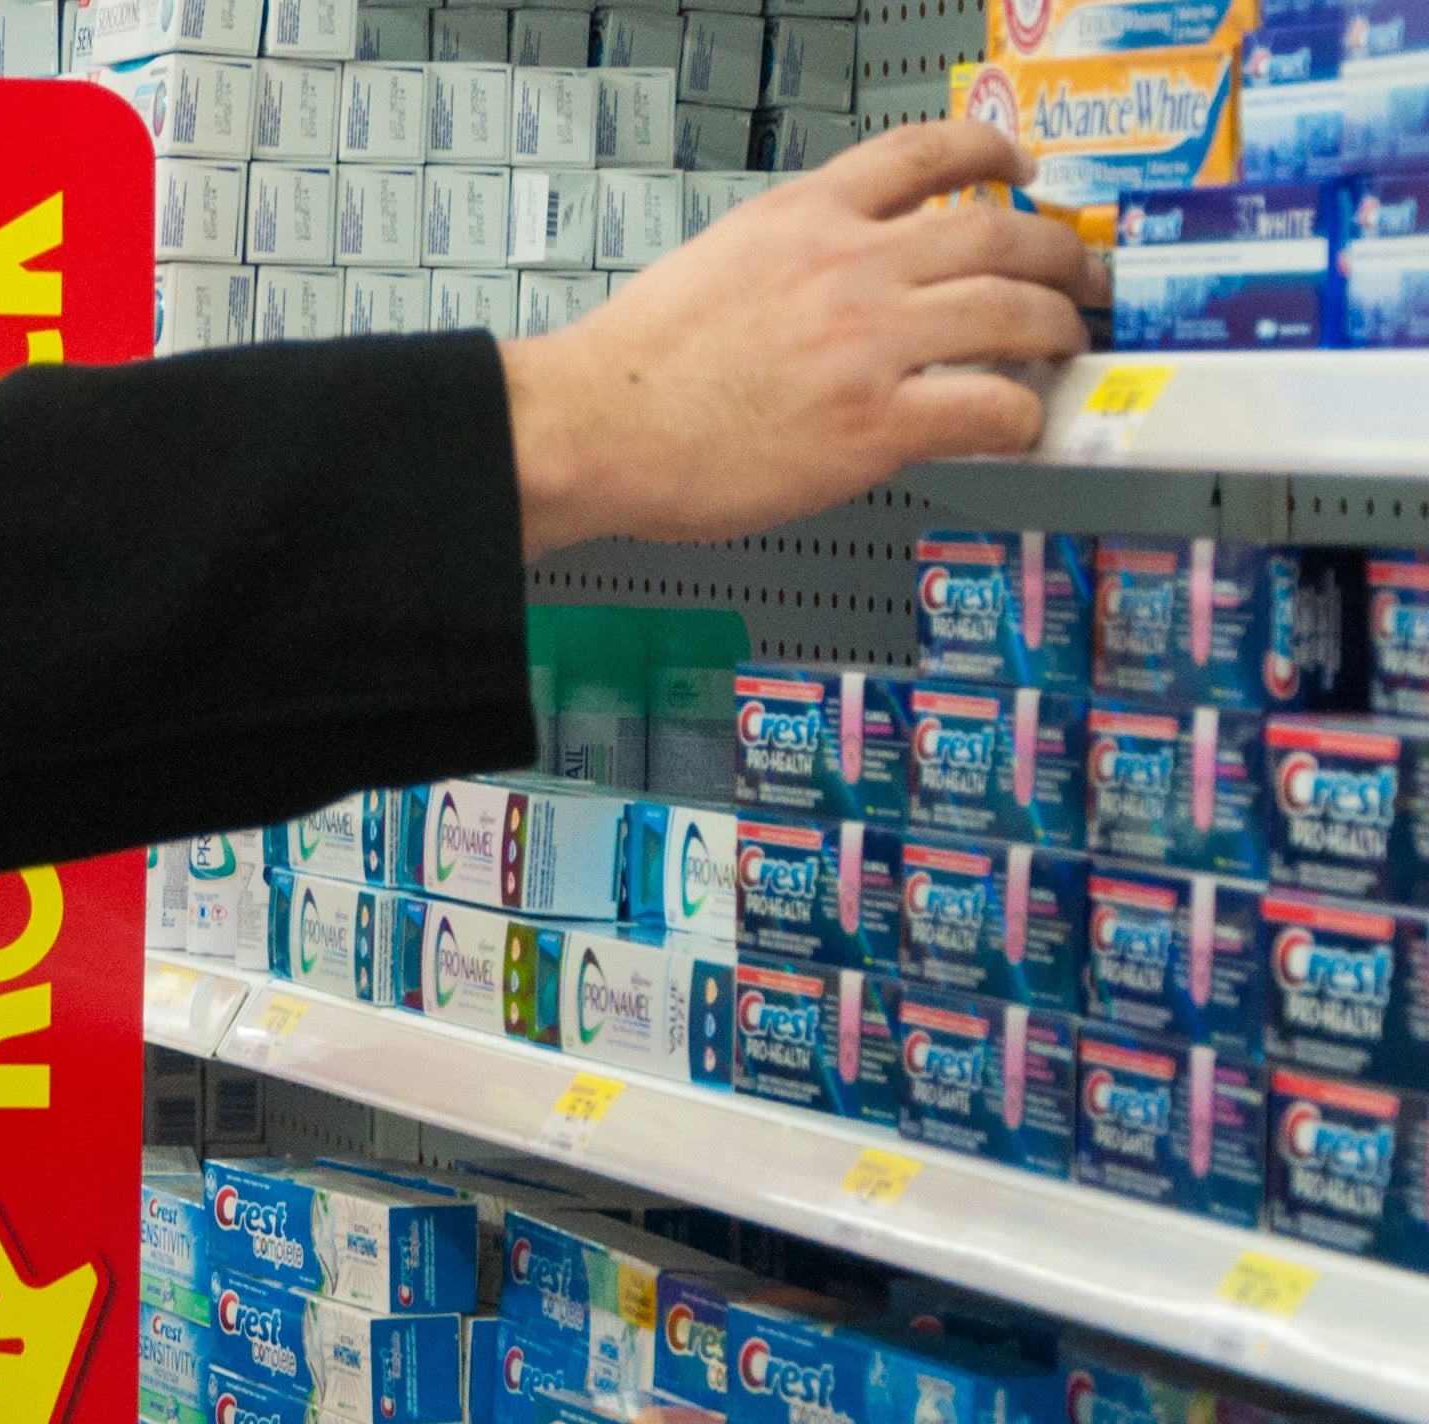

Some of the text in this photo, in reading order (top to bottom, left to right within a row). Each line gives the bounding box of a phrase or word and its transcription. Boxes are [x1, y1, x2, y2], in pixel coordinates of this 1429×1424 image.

[920, 567, 1003, 616] Crest
[738, 701, 820, 750] Crest
[915, 718, 994, 768] Crest
[1277, 752, 1399, 827] Crest
[442, 823, 494, 857] PRONAMEL
[740, 845, 819, 899] Crest
[906, 872, 986, 926] Crest
[304, 918, 349, 953] PRONAMEL
[440, 951, 494, 986] PRONAMEL
[1273, 927, 1394, 999] Crest
[584, 985, 652, 1023] PRONAMEL
[740, 990, 819, 1046] Crest
[904, 1030, 985, 1093] Crest
[1280, 1101, 1395, 1175] Crest
[149, 1198, 179, 1225] Crest
[214, 1184, 288, 1244] Crest
[141, 1220, 191, 1260] ENSITIVITY
[252, 1235, 305, 1270] complete
[509, 1237, 572, 1301] Crest
[152, 1314, 183, 1342] Crest
[218, 1288, 282, 1346] Crest
[252, 1340, 298, 1378] complete
[739, 1336, 835, 1408] Crest
